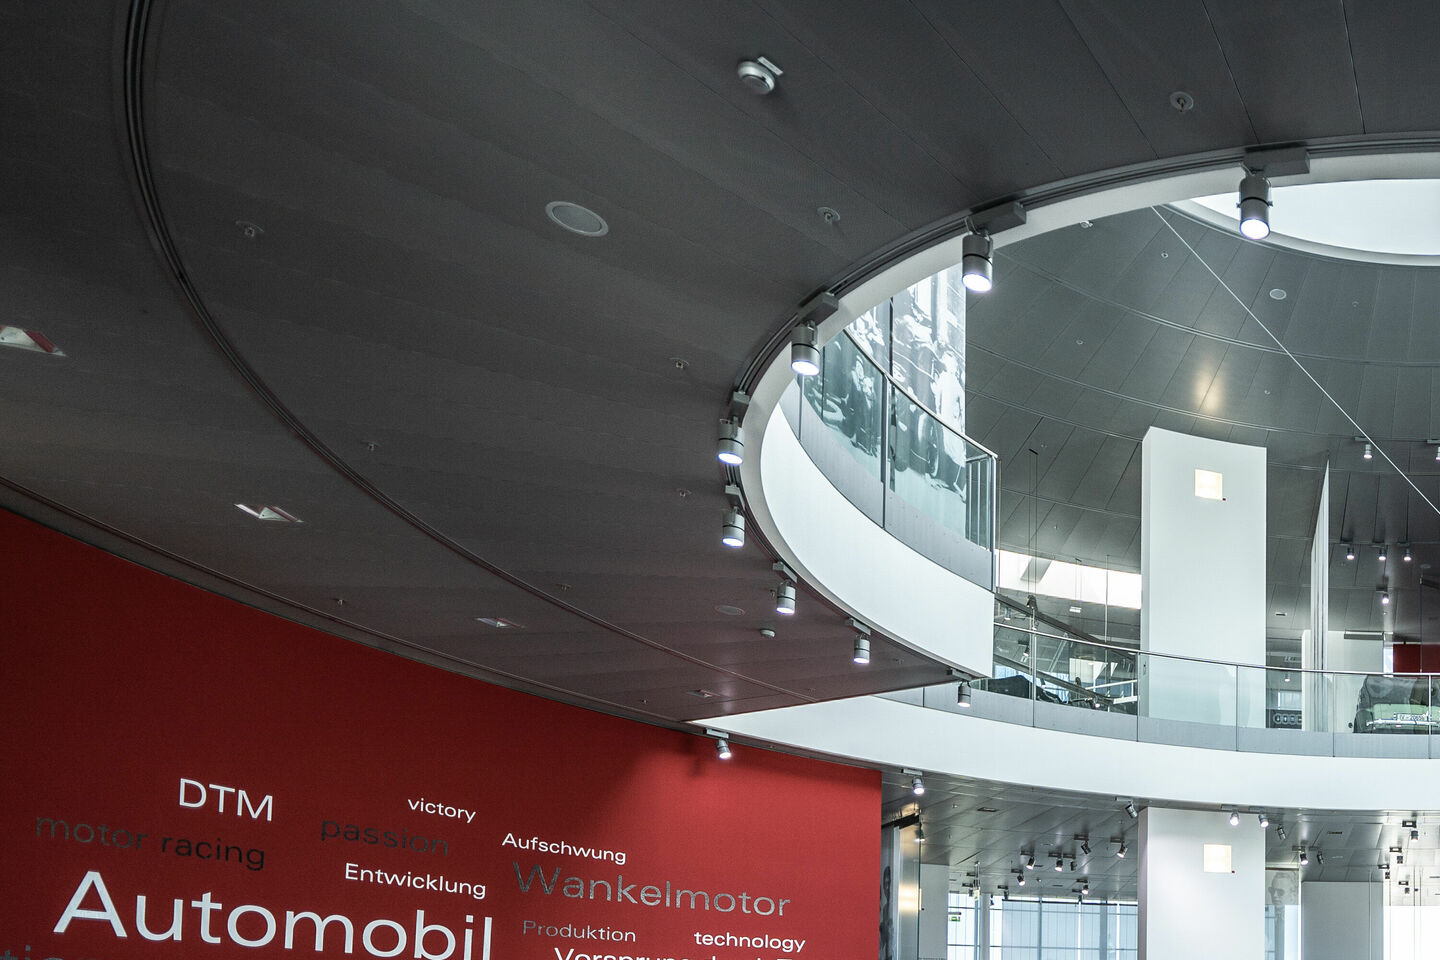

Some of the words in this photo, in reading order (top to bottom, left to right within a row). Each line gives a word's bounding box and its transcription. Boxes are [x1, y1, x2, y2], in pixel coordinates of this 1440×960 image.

[179, 778, 274, 822] DTM
[407, 797, 477, 824] victory
[36, 816, 148, 851] motor
[161, 835, 266, 872] racing
[321, 819, 449, 856] passion
[501, 832, 627, 866] Aufschwung
[344, 862, 487, 899] Entwicklung
[512, 860, 791, 917] Wankelmotor
[522, 920, 637, 943] Produktion
[693, 931, 806, 954] technology
